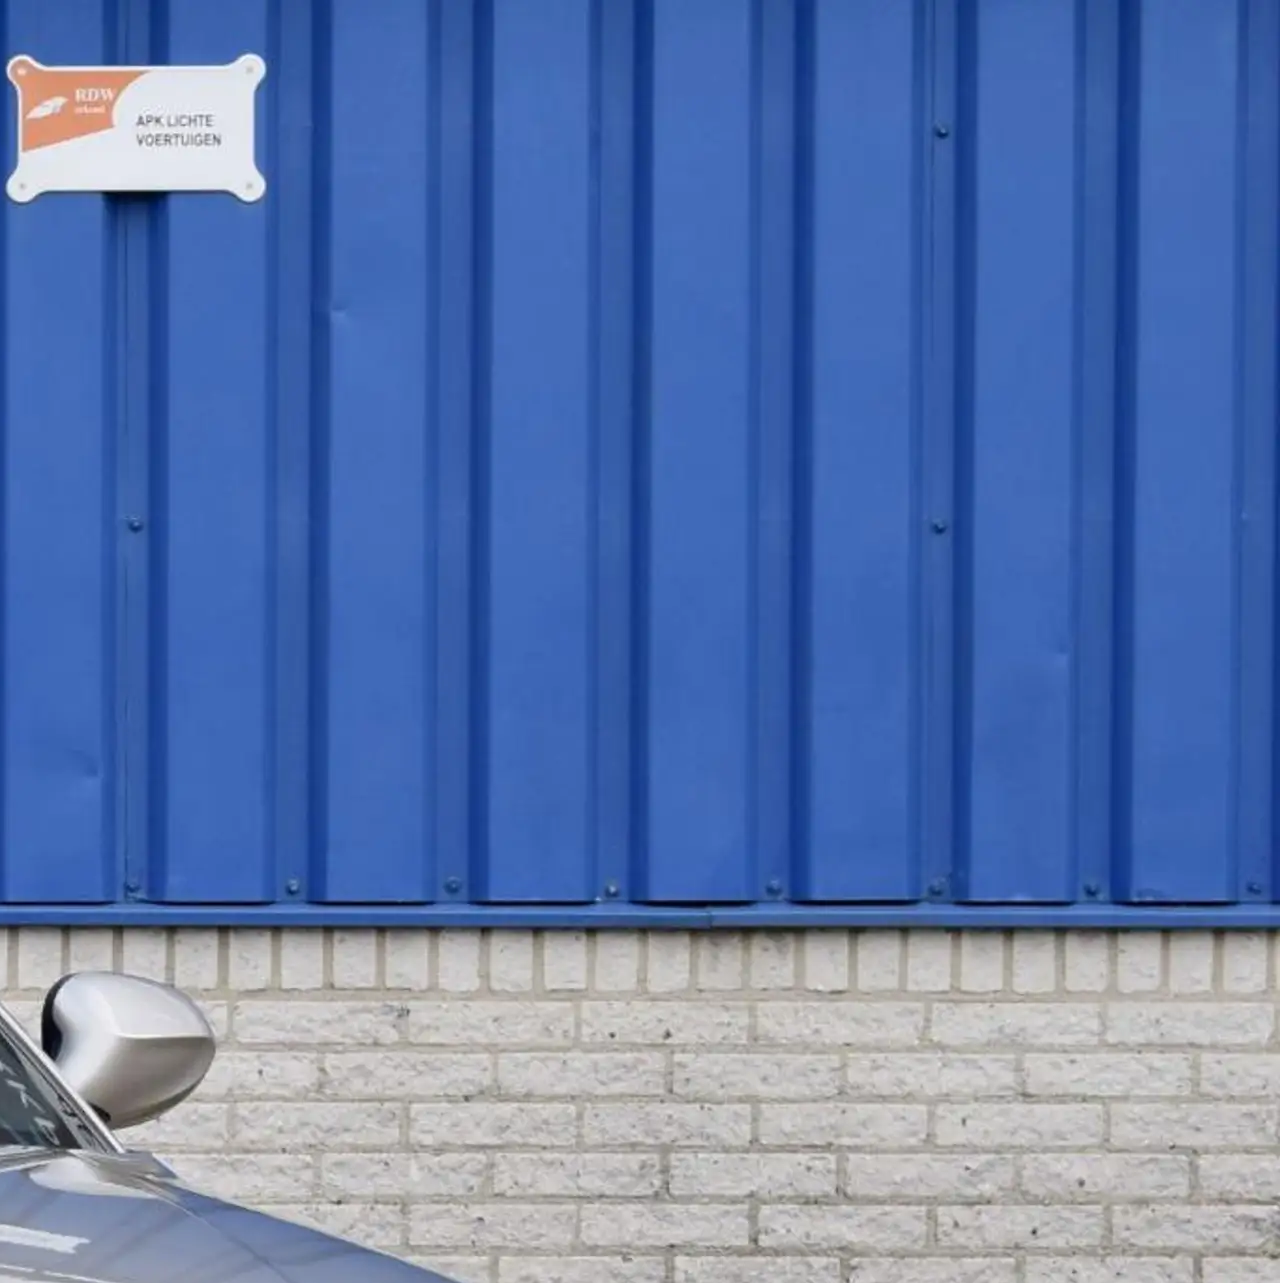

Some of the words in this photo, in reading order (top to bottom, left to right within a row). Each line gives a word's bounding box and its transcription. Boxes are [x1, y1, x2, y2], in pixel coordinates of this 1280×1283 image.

[74, 87, 115, 102] RDW
[136, 115, 164, 127] APK
[167, 114, 215, 127] LICHTE
[136, 133, 222, 147] VOERTUIGEN
